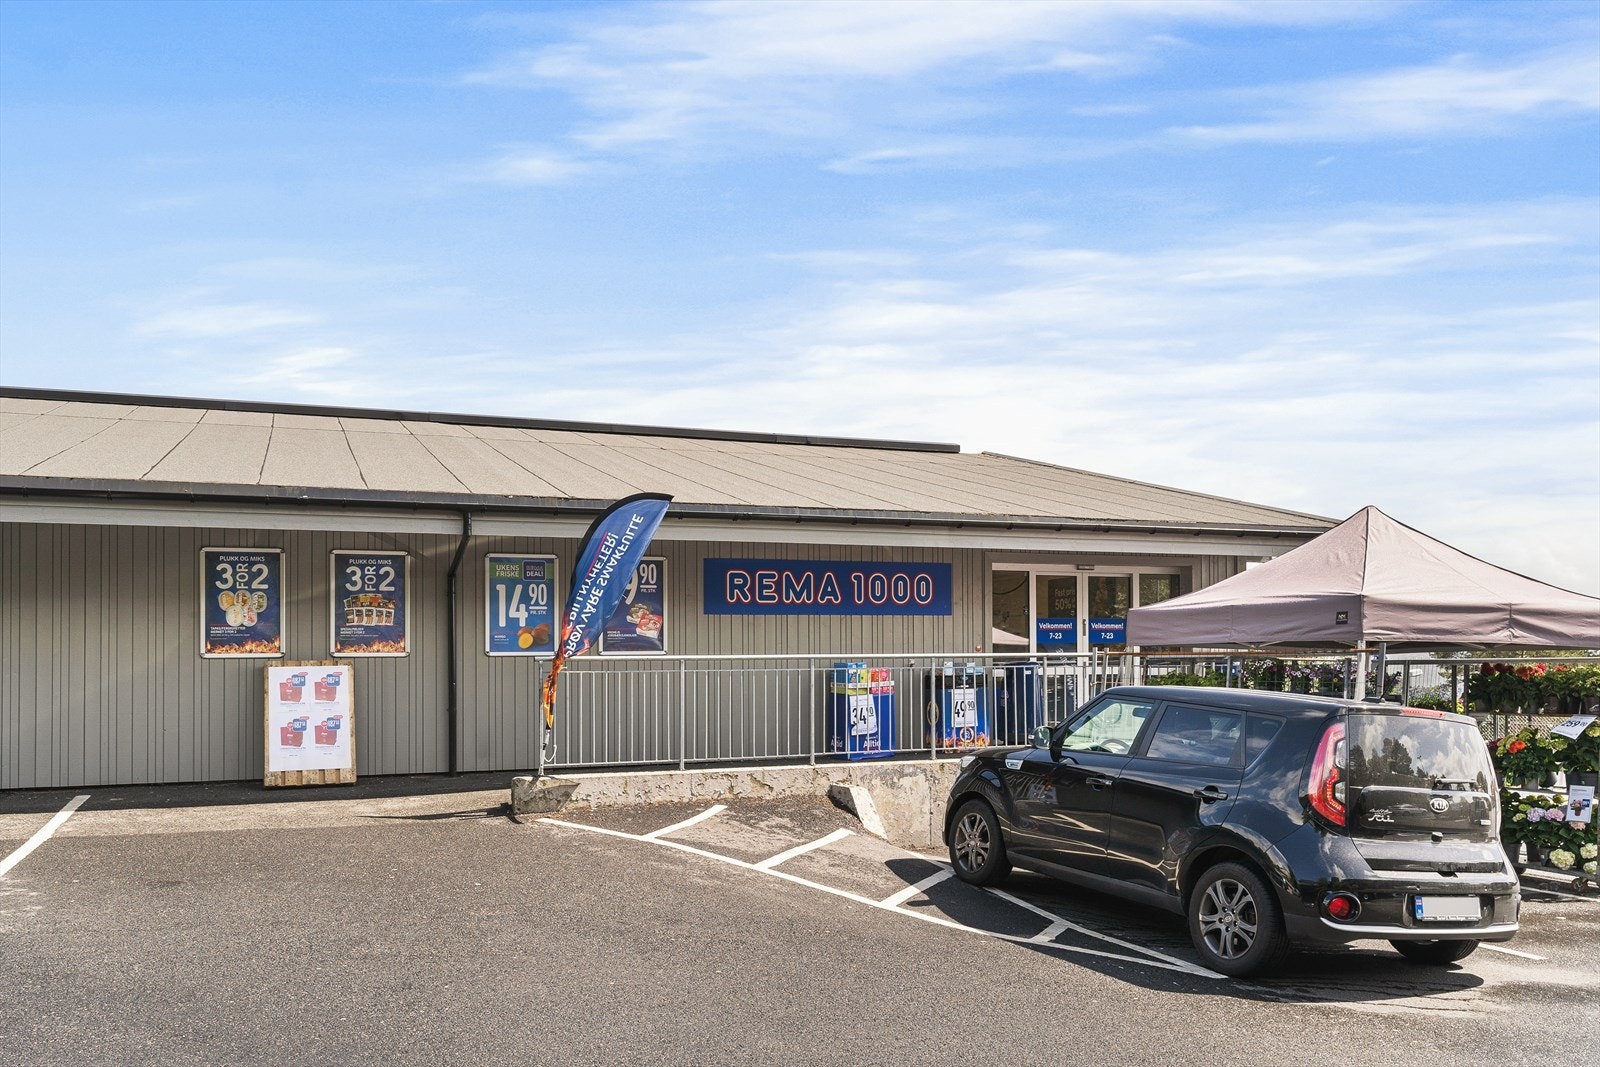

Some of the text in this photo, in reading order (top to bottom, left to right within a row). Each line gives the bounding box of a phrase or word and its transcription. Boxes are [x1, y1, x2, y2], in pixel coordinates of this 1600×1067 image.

[215, 563, 269, 590] 3 FOR 2
[345, 566, 395, 591] 3 FOR 2
[639, 563, 657, 584] 90
[726, 570, 933, 605] REMA 1000
[495, 583, 548, 628] 14 90
[1049, 632, 1063, 640] 7-23
[1100, 632, 1114, 640] 7-23
[1433, 800, 1447, 809] KIA
